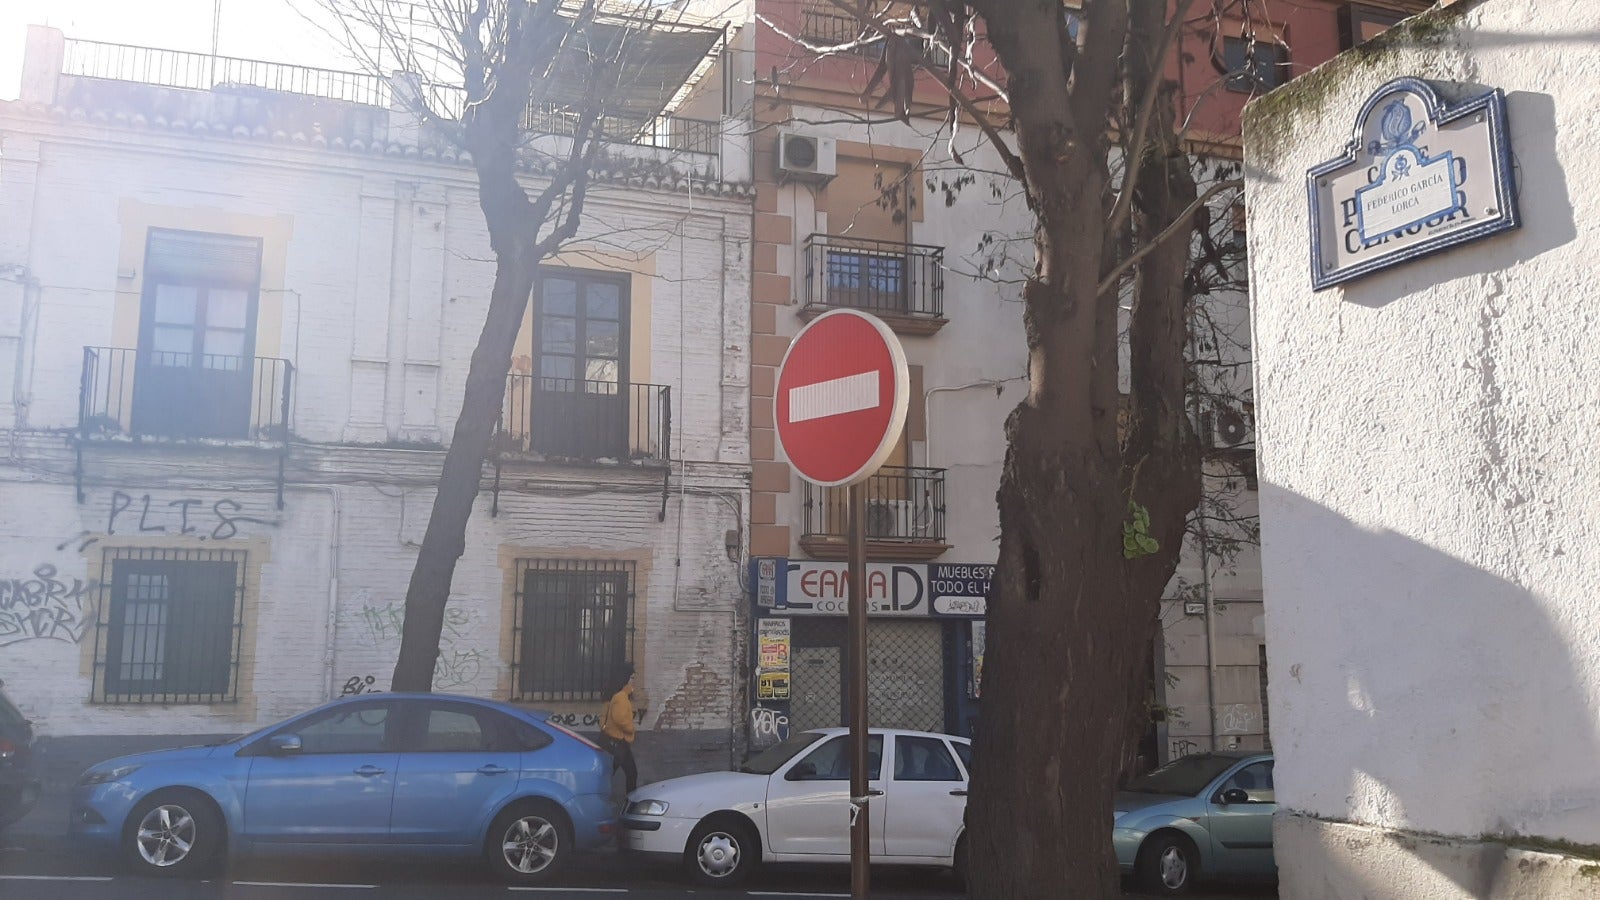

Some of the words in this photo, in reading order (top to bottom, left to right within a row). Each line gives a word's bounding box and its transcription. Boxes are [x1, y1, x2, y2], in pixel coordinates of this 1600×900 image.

[1367, 187, 1409, 211] FEDERICO
[1411, 173, 1443, 194] GARCÍA
[1391, 197, 1420, 214] LORCA
[937, 566, 985, 579] MUEBLES
[930, 580, 964, 593] TODO
[967, 581, 980, 594] EL
